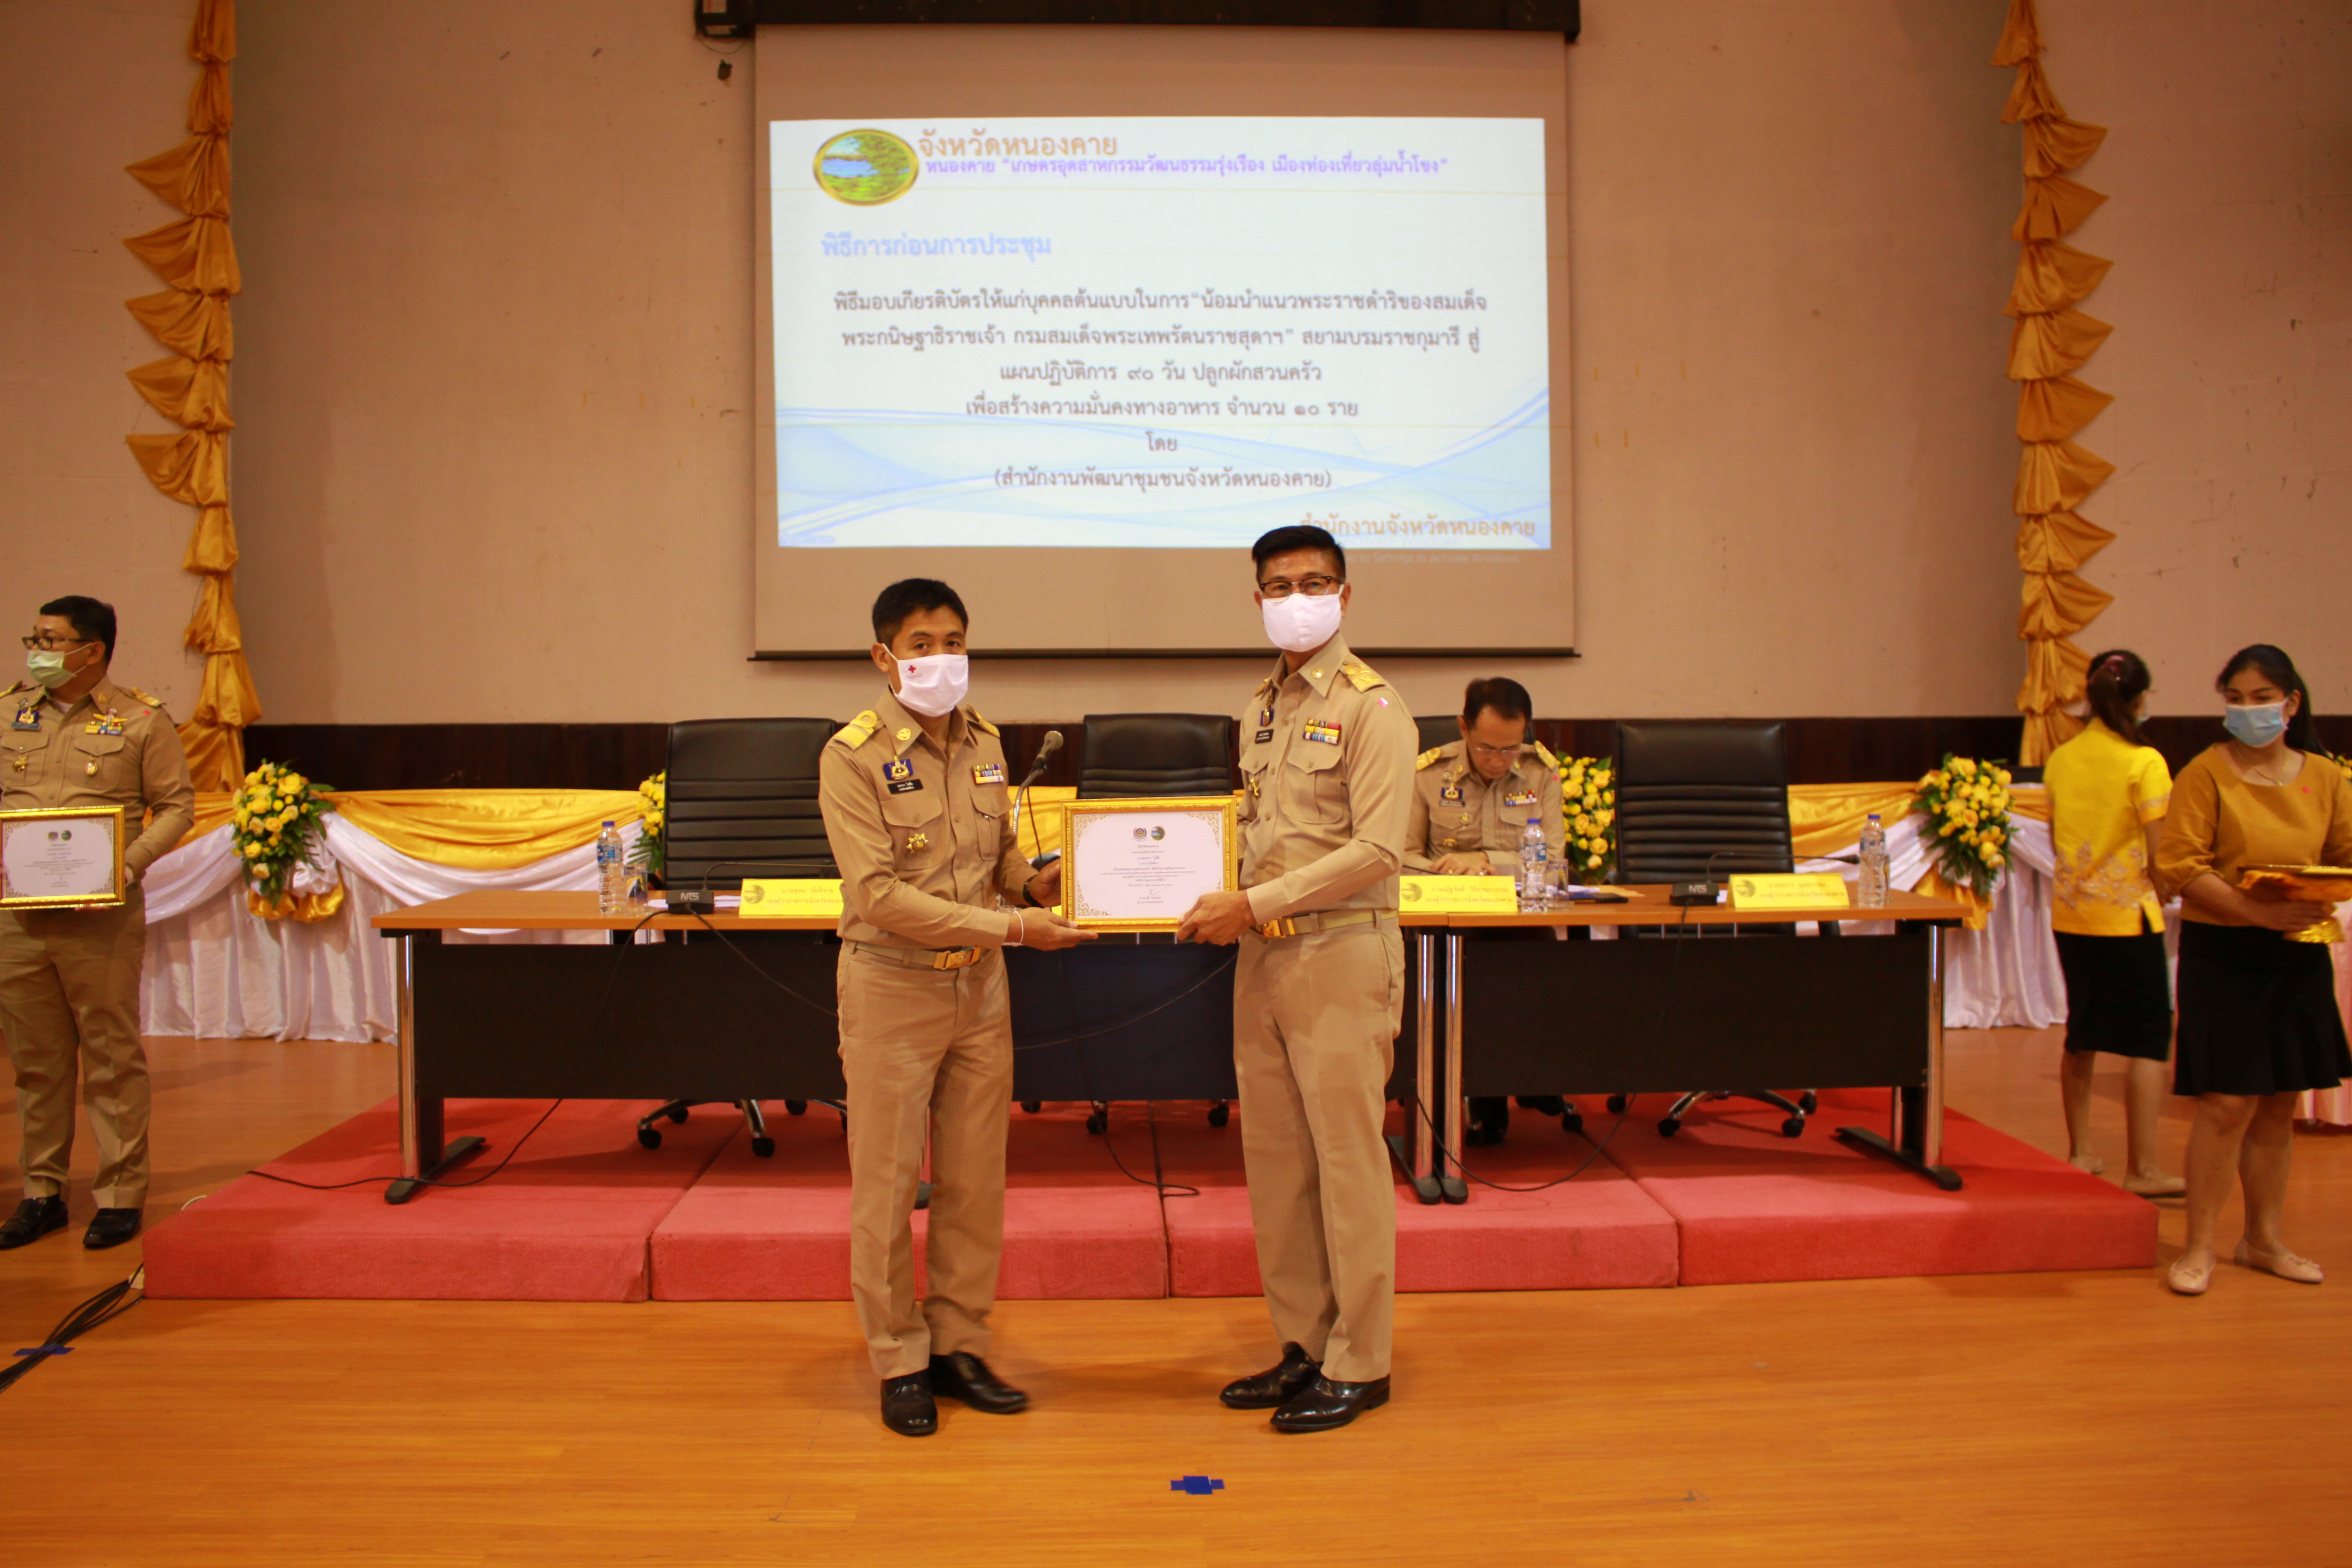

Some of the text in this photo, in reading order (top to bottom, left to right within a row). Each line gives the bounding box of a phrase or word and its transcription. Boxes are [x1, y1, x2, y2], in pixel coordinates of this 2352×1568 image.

[918, 128, 1118, 156] จังหวัดหนองคาย
[926, 159, 995, 173] หนองคาย
[821, 231, 1052, 262] พิธีการก่อนการประชุม
[842, 324, 1005, 352] พระกนิษฐาธิราชเจ้า
[1303, 326, 1459, 352] สยามบรมราชกุมารี
[1469, 327, 1479, 353] สู่
[1000, 360, 1322, 387] แผนปฏิบัติการ ๙๐ วัน ปลูกผักสวนครัว
[967, 391, 1358, 416] เพื่อสร้างความมั่นคงทางอาหาร จำนวน ๑๐ ราย
[1146, 431, 1177, 451] โดย
[995, 466, 1331, 493] (สำนักงานพัฒนาชุมชนจังหวัดหนองคาย)
